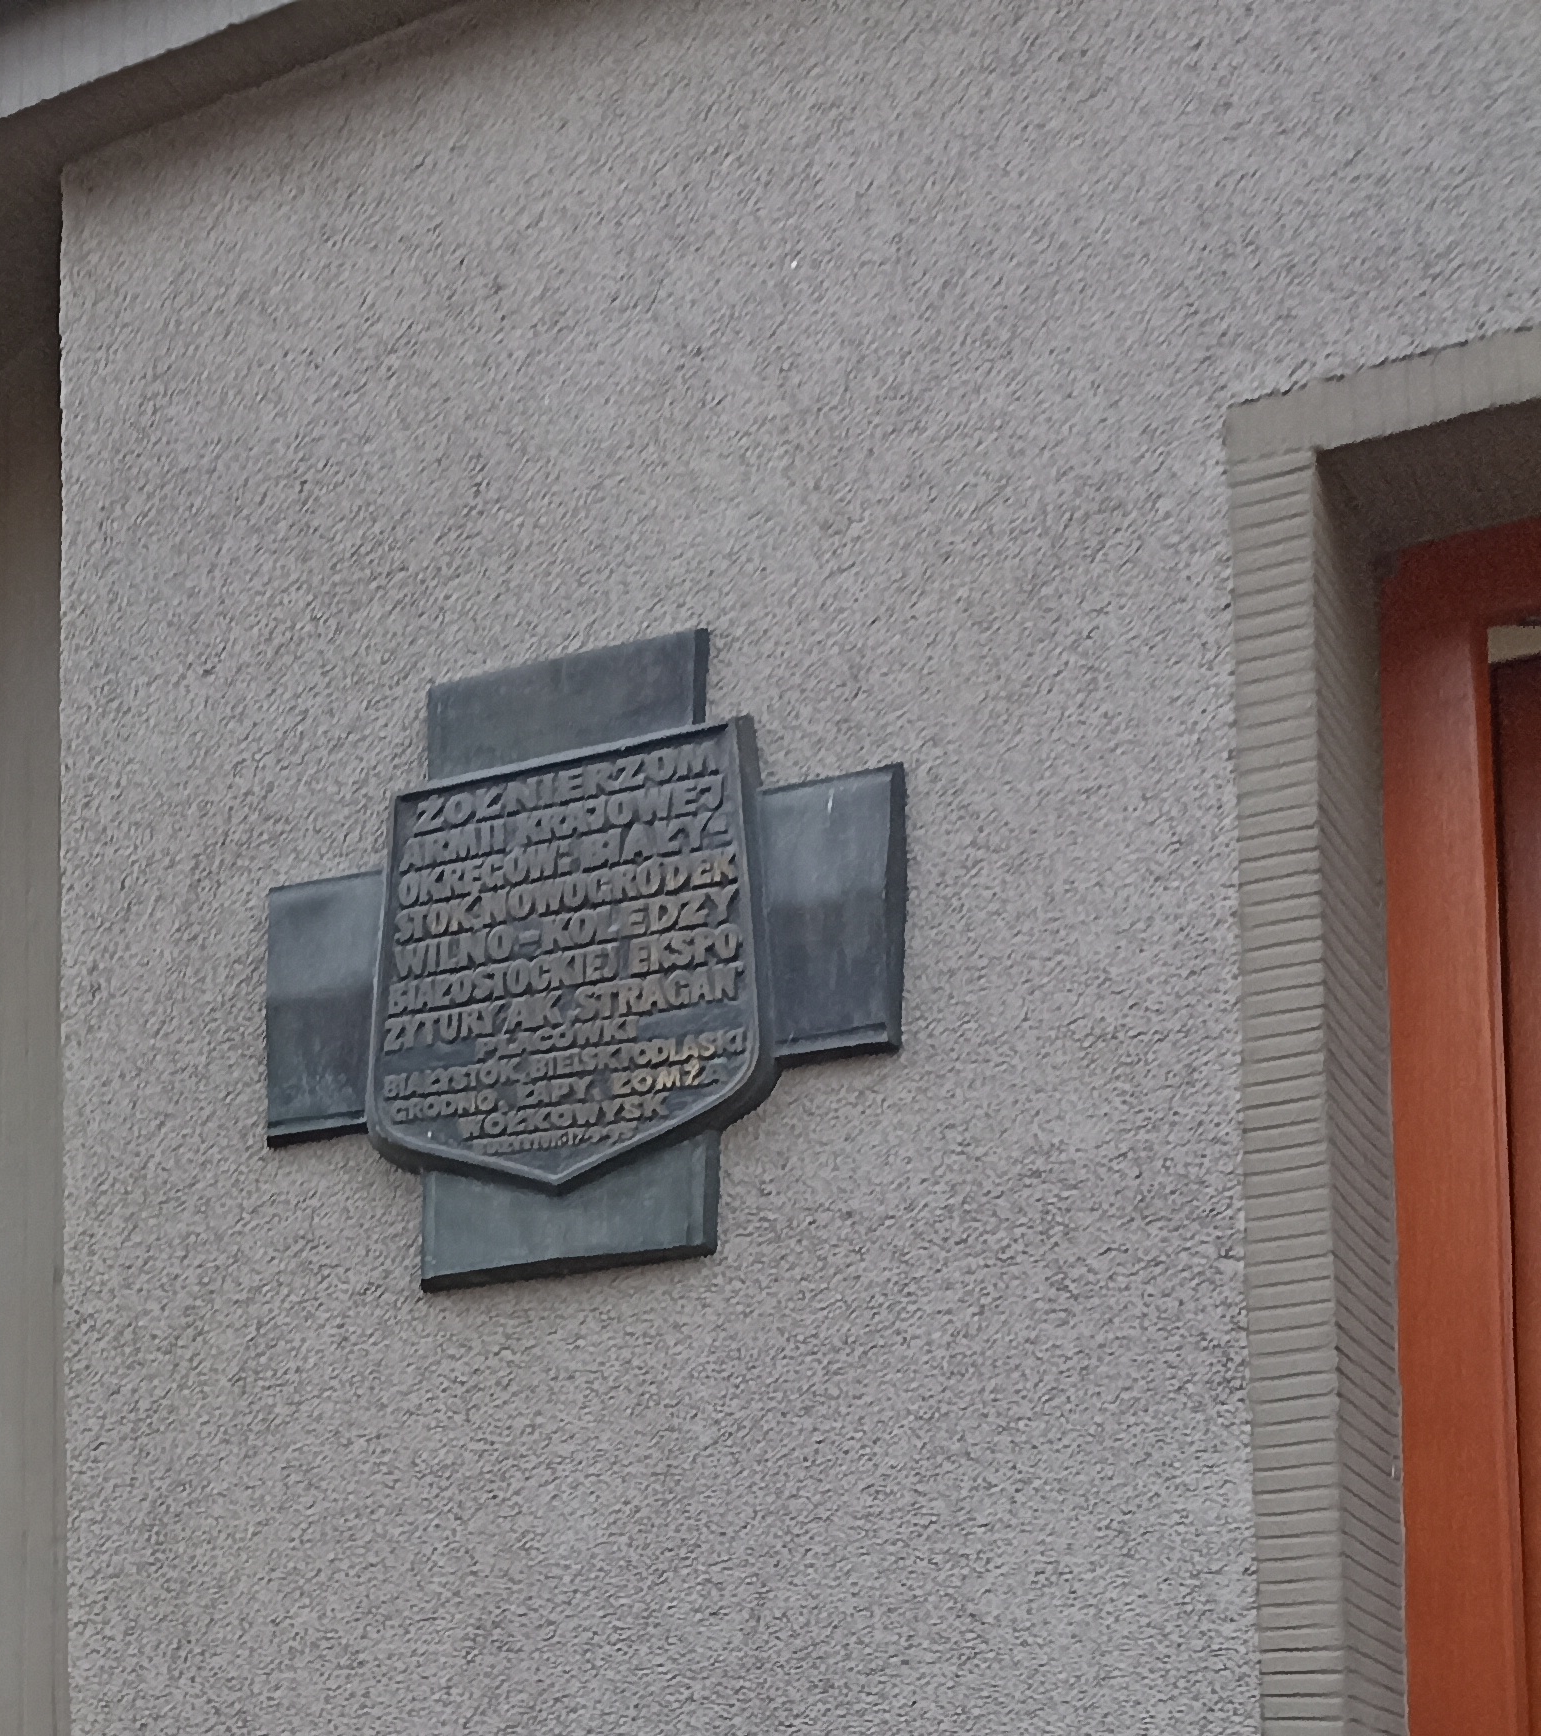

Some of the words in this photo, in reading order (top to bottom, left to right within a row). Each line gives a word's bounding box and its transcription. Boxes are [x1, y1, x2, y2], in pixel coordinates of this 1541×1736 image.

[399, 819, 506, 873] ARMII
[513, 774, 724, 848] KRAJOWEJ
[413, 741, 718, 836] ŻOŁNIERZOM
[394, 924, 515, 978] WILNO
[542, 884, 739, 953] KOLEDZY
[388, 942, 619, 1018] BIAŁOSTOCKIEJ
[384, 1001, 505, 1053] ZYTURY
[504, 991, 563, 1034] AK
[531, 1043, 623, 1082] BIELSK
[611, 1057, 728, 1096] ŁOMŻA
